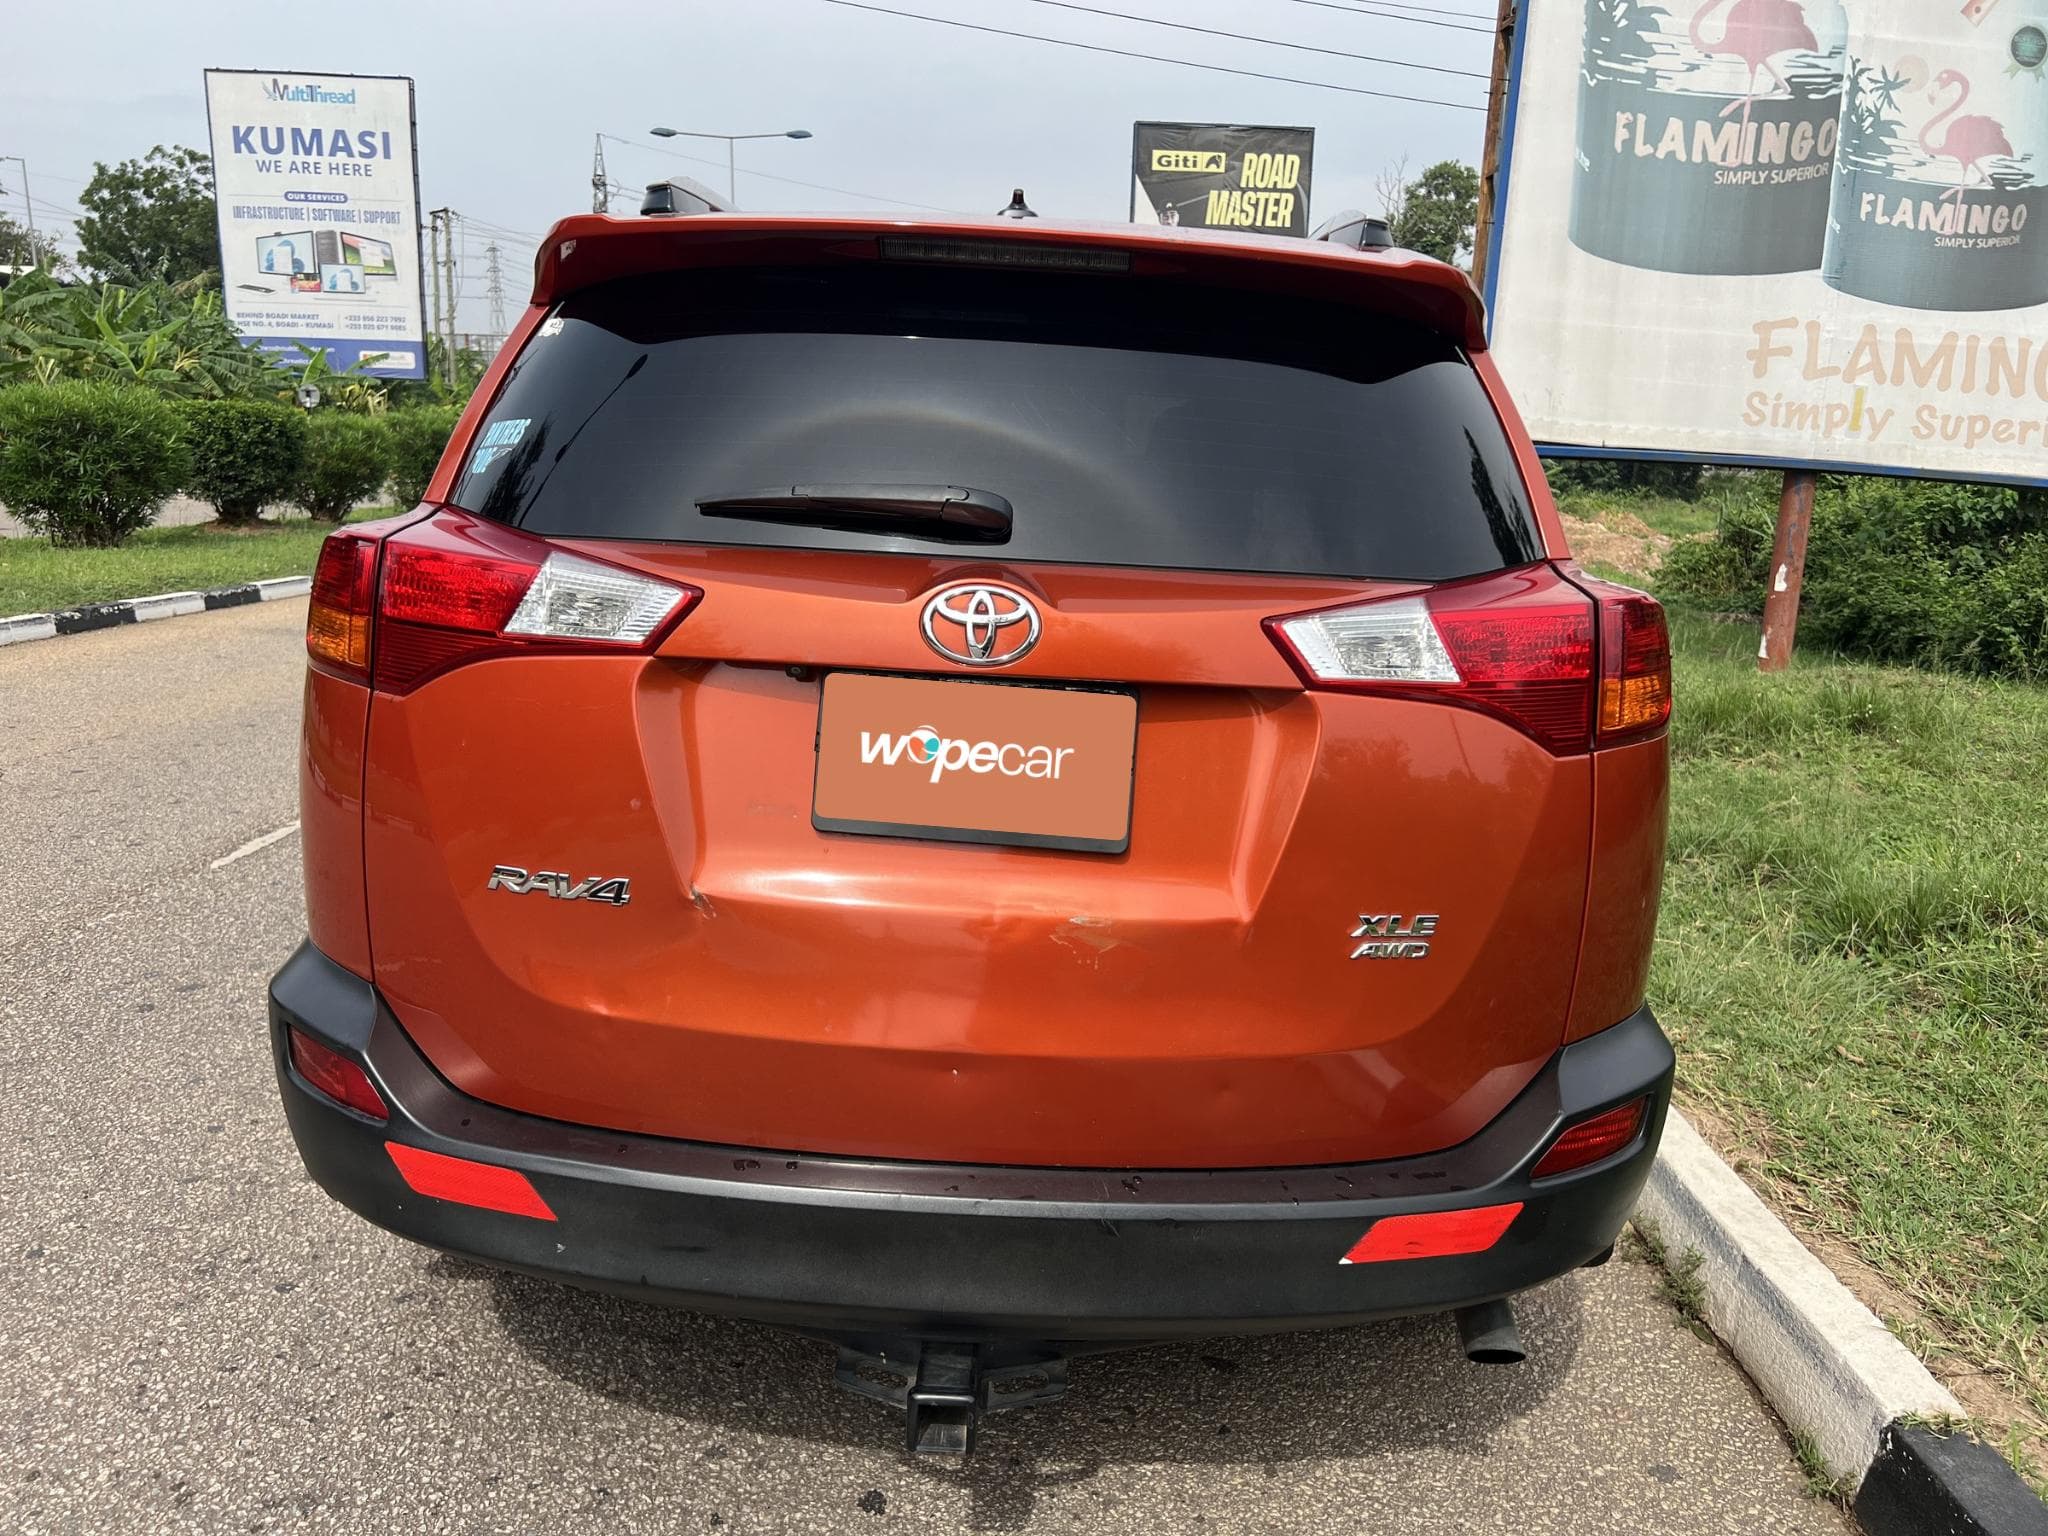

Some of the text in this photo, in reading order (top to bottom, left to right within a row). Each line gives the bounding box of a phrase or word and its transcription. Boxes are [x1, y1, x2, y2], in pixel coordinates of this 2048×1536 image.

[231, 125, 392, 160] KUMASI
[1614, 111, 1838, 169] FLAMINGO
[256, 159, 373, 177] WE ARE HERE
[1157, 154, 1198, 169] Giti
[1239, 152, 1301, 190] ROAD
[1714, 162, 1830, 185] SIMPLY SUPERIOR
[287, 192, 345, 203] OUR SERVICES
[1205, 189, 1295, 228] MASTER
[232, 205, 305, 221] INFRASTRUCTURE
[312, 208, 357, 223] SOFTWARE
[363, 210, 401, 224] SUPPORT
[1859, 191, 2028, 236] FLAMINGO
[1934, 236, 1975, 249] SIMPLY
[1743, 387, 1895, 441] Simply
[487, 864, 631, 906] RAV4
[1350, 914, 1440, 937] XLE
[1349, 942, 1429, 959] AWD
